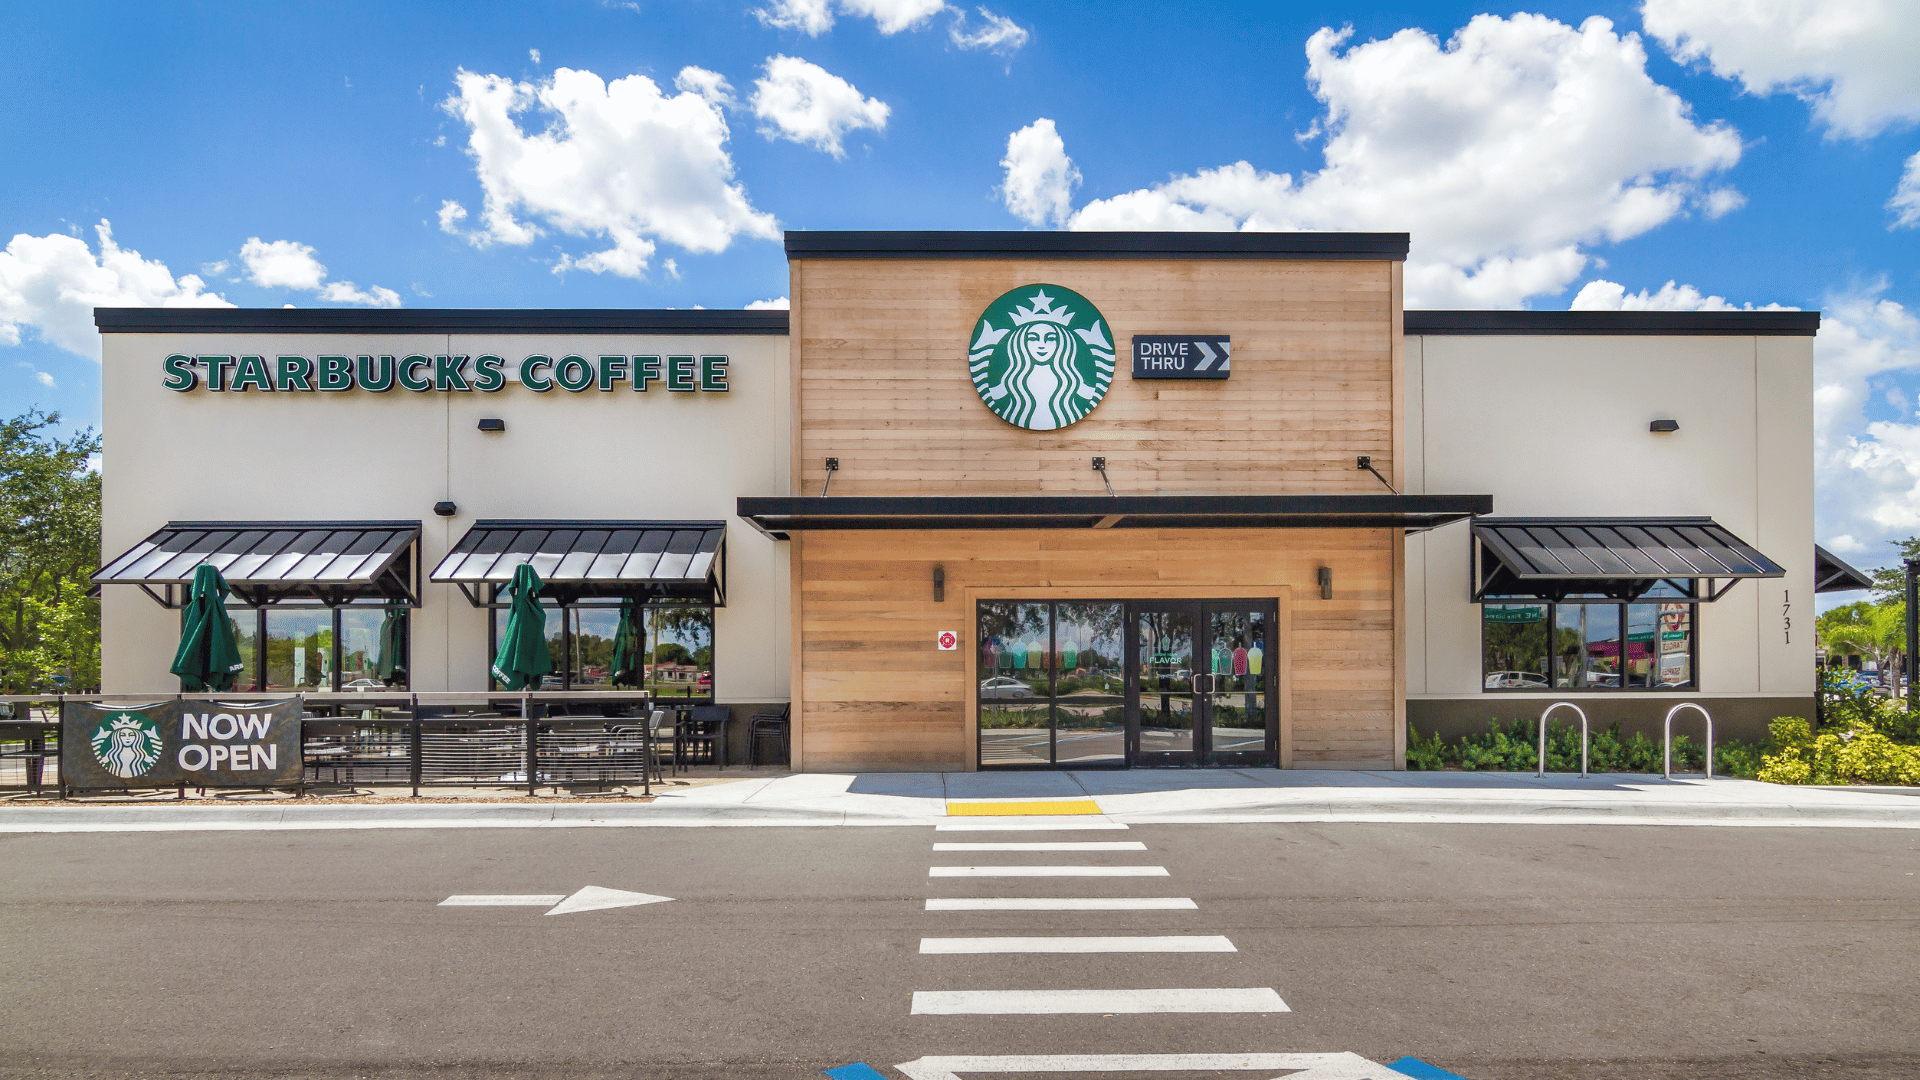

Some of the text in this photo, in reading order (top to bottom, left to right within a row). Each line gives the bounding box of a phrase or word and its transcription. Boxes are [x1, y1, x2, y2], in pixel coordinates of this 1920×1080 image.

[1140, 342, 1189, 356] DRIVE
[162, 354, 730, 392] STARBUCKS COFFEE
[1140, 356, 1185, 370] THRU
[1782, 589, 1791, 645] 1731
[182, 713, 272, 740] NOW
[178, 744, 277, 771] OPEN
